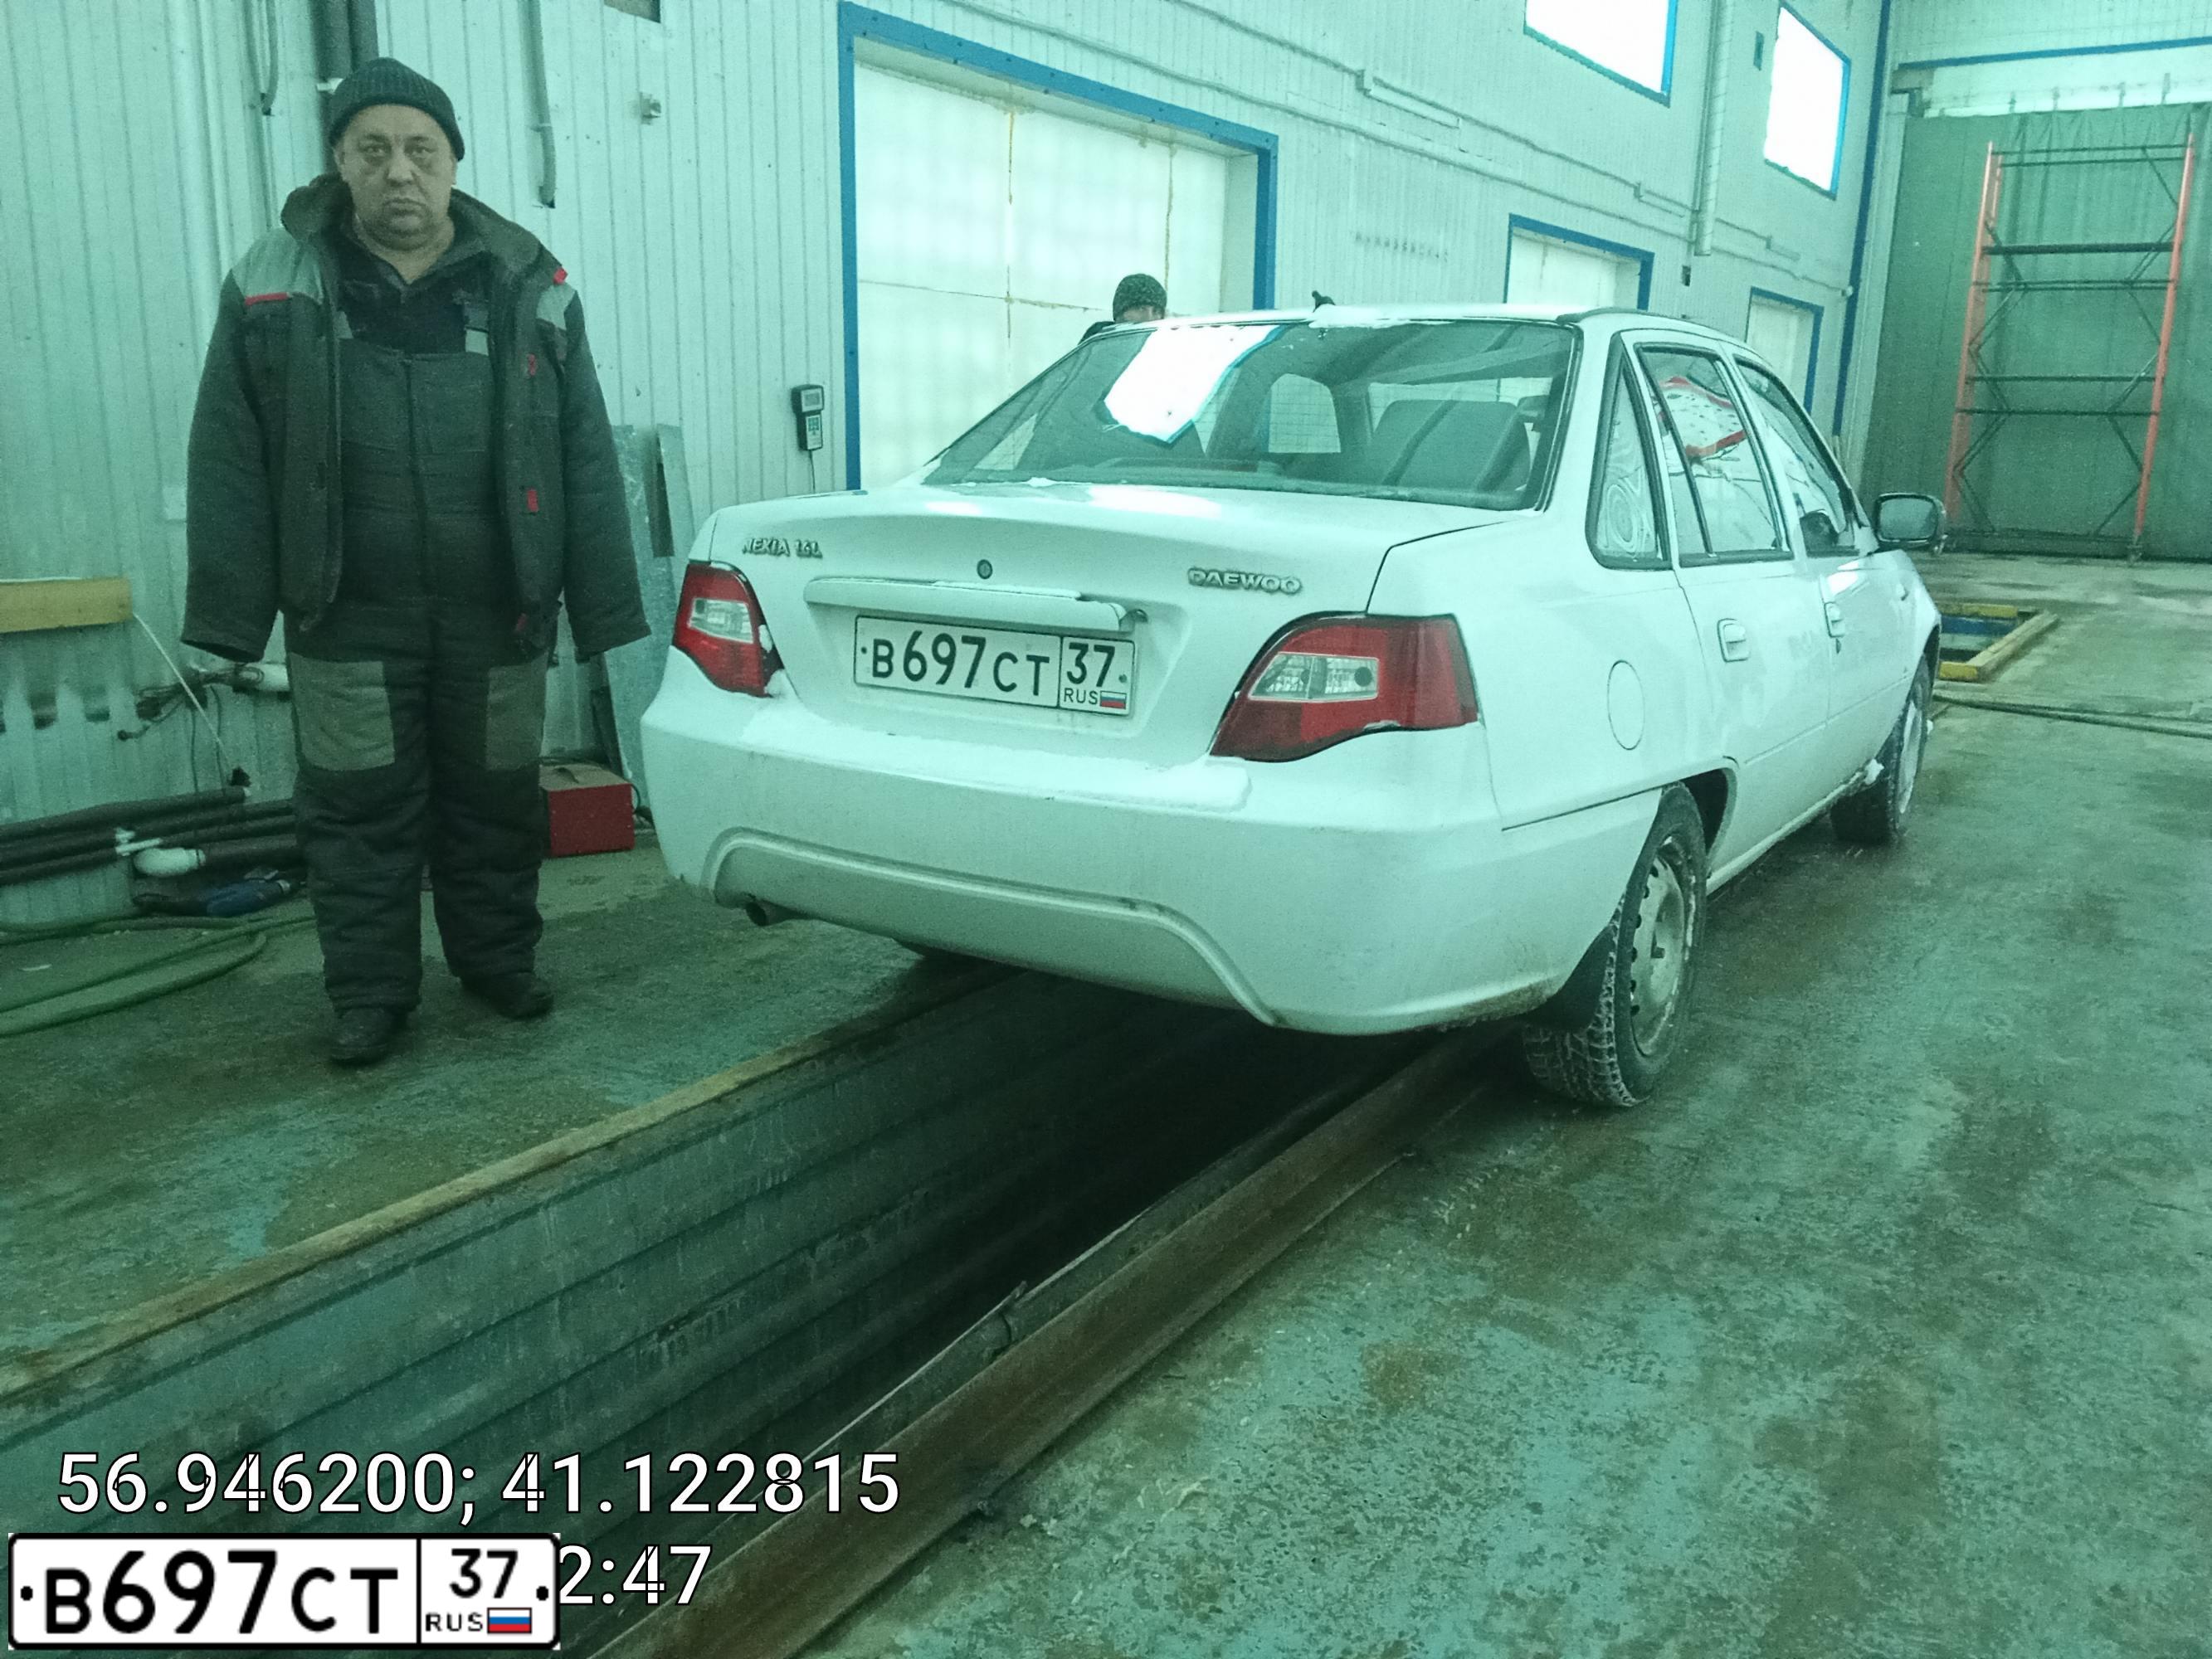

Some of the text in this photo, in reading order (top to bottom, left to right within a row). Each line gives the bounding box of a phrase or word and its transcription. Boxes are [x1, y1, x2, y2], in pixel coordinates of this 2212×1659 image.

[742, 538, 791, 557] NEXIA
[1187, 567, 1303, 596] DAEWOO
[1065, 641, 1116, 688] 37
[1063, 687, 1099, 705] RUS
